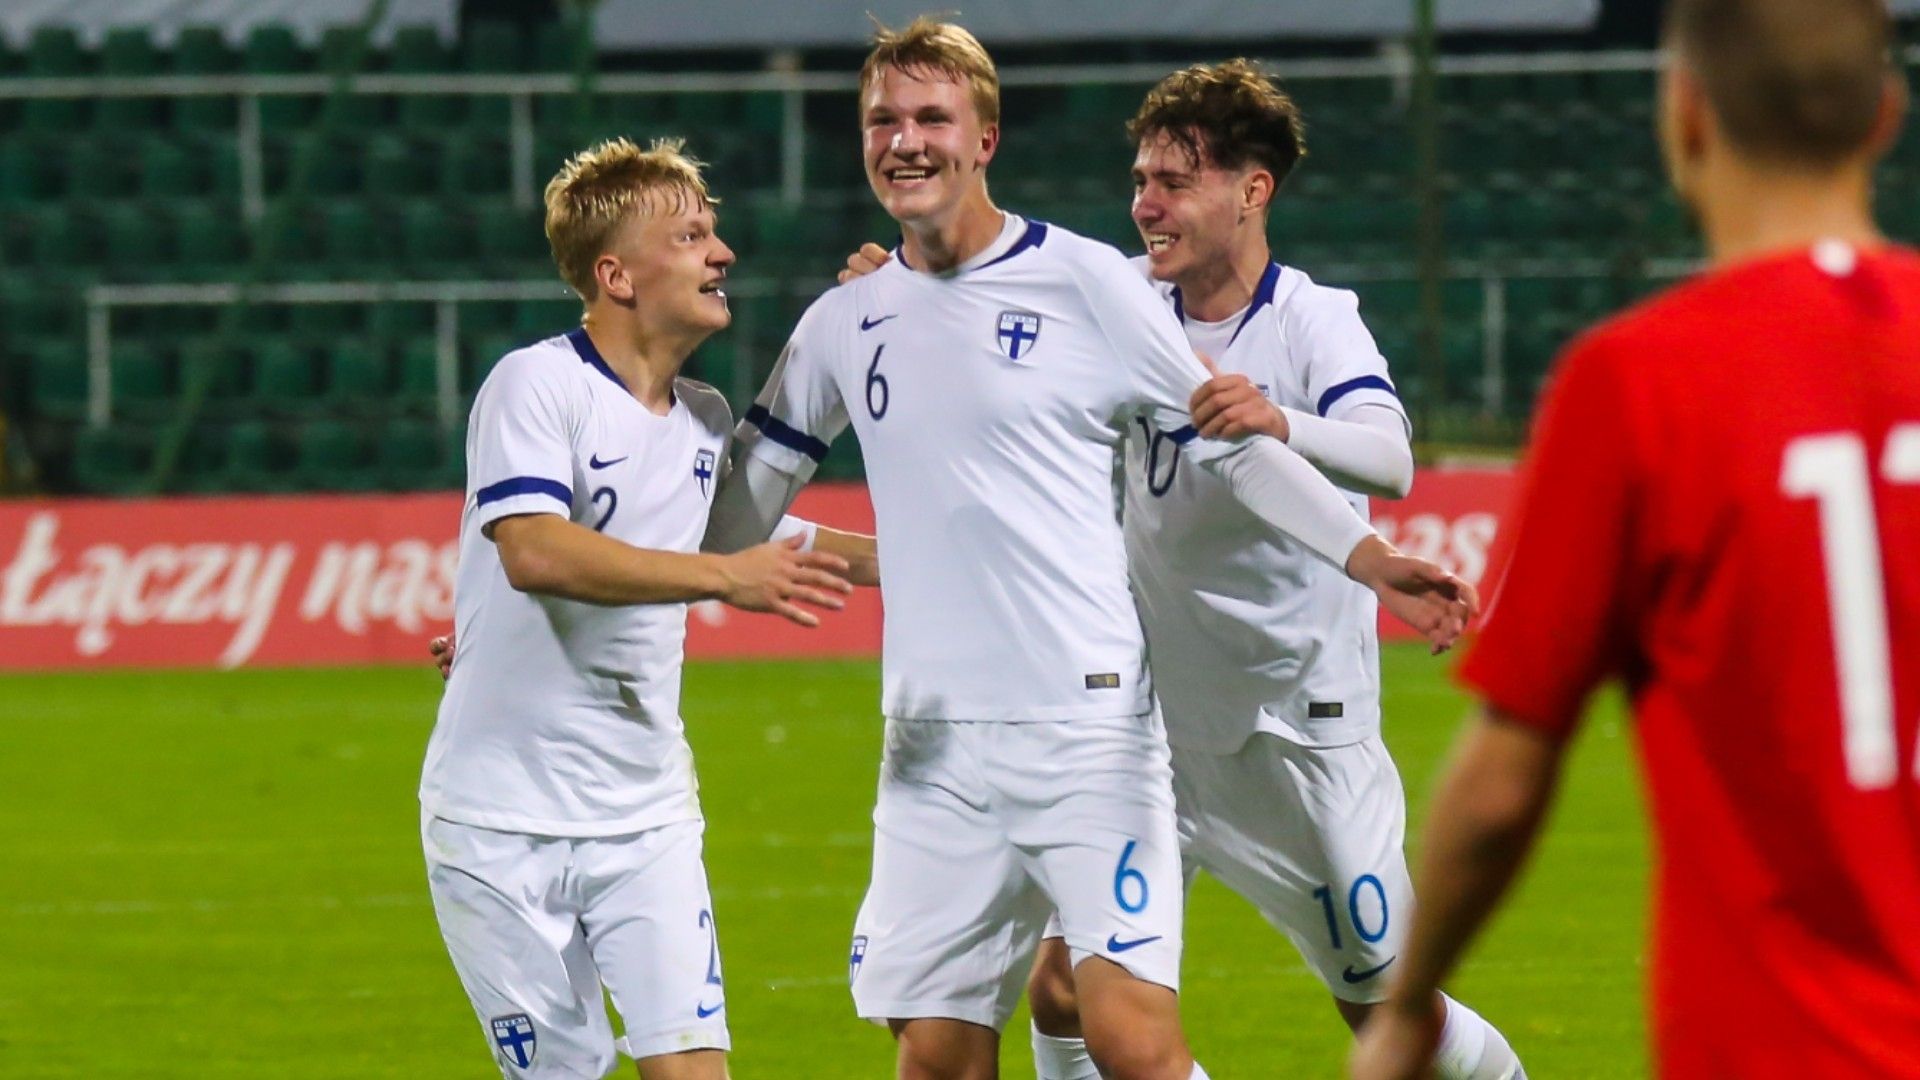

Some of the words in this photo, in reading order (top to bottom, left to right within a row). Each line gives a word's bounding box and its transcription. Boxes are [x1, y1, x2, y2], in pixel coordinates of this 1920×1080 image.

[866, 343, 889, 422] 6
[1135, 415, 1180, 498] 10
[591, 486, 618, 533] 2
[0, 510, 296, 670] Łączy
[1779, 422, 1920, 792] 1
[1114, 839, 1149, 914] 6
[1312, 873, 1389, 951] 10
[699, 909, 722, 986] 2
